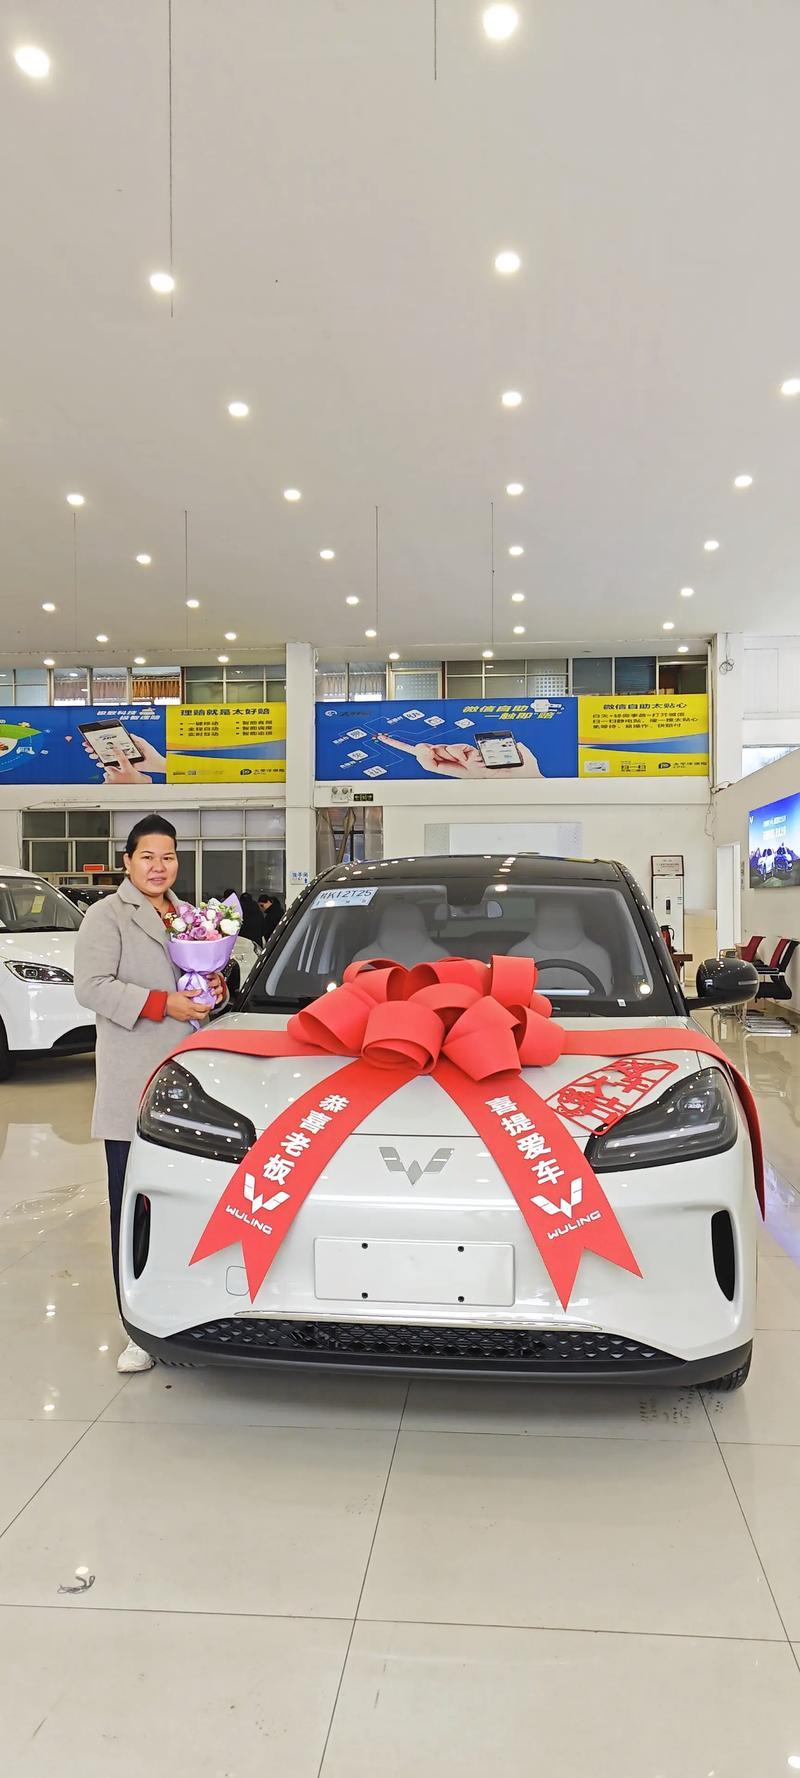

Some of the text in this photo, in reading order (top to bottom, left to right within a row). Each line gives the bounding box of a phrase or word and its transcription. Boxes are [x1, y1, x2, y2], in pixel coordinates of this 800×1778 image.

[180, 708, 270, 717] 理赔就是太好赔
[463, 705, 530, 713] 微信自助
[603, 703, 688, 711] 微信自助太贴心
[263, 1094, 350, 1186] 恭喜老板
[484, 1095, 565, 1185] 喜提爱车
[225, 1204, 273, 1235] WULING
[547, 1209, 602, 1240] WULING
